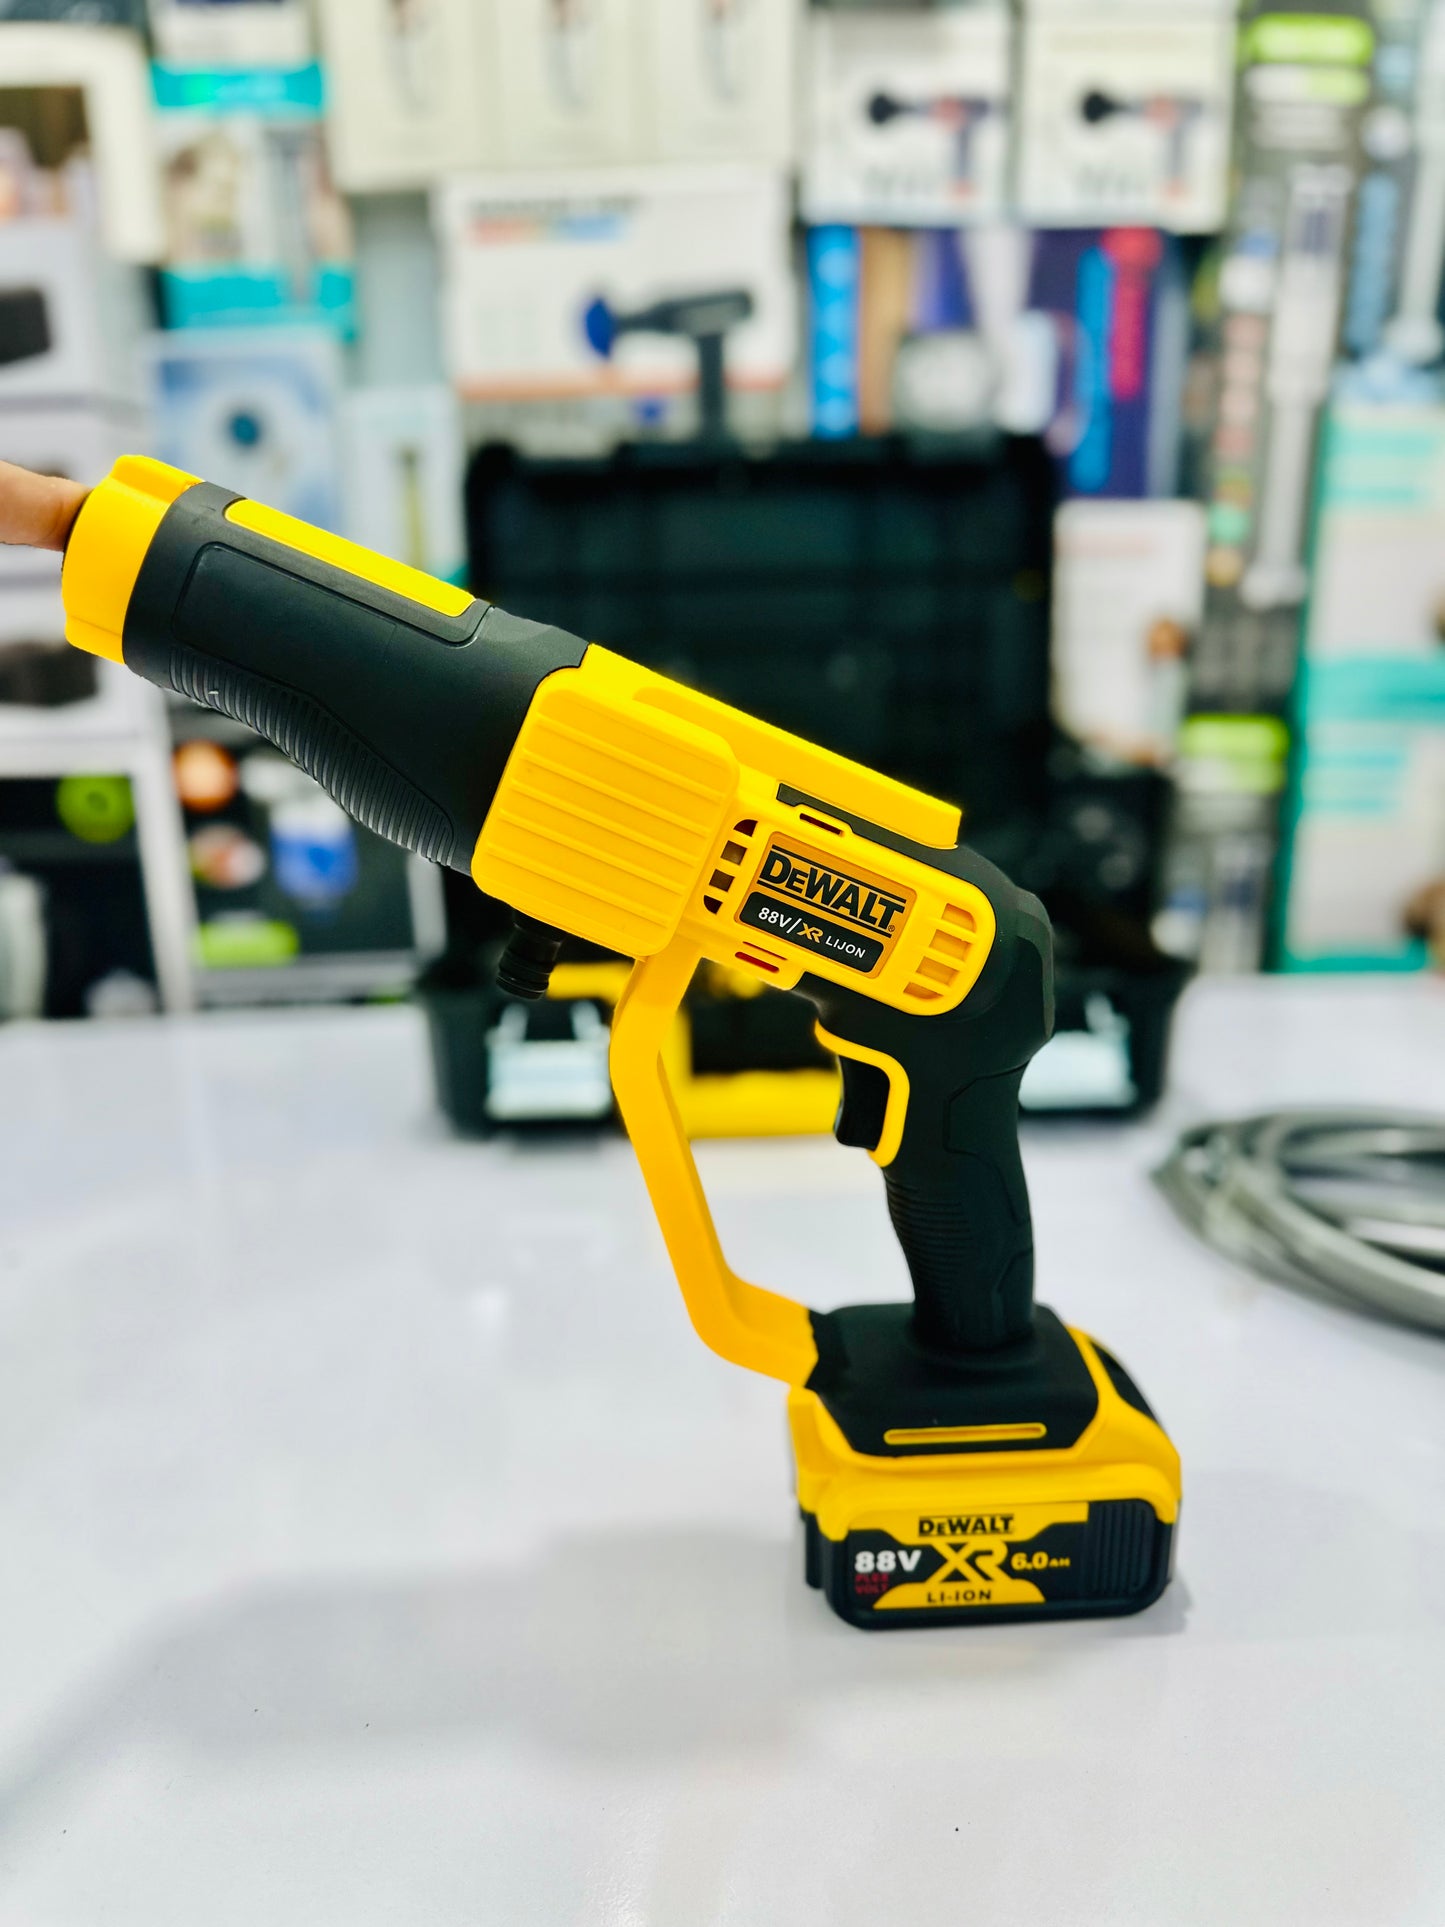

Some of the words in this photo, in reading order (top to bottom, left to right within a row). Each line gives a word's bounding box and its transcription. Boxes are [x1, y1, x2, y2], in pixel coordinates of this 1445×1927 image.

[854, 1550, 922, 1574] 88V
[924, 1541, 1014, 1584] XR
[926, 1589, 992, 1604] LI-ION
